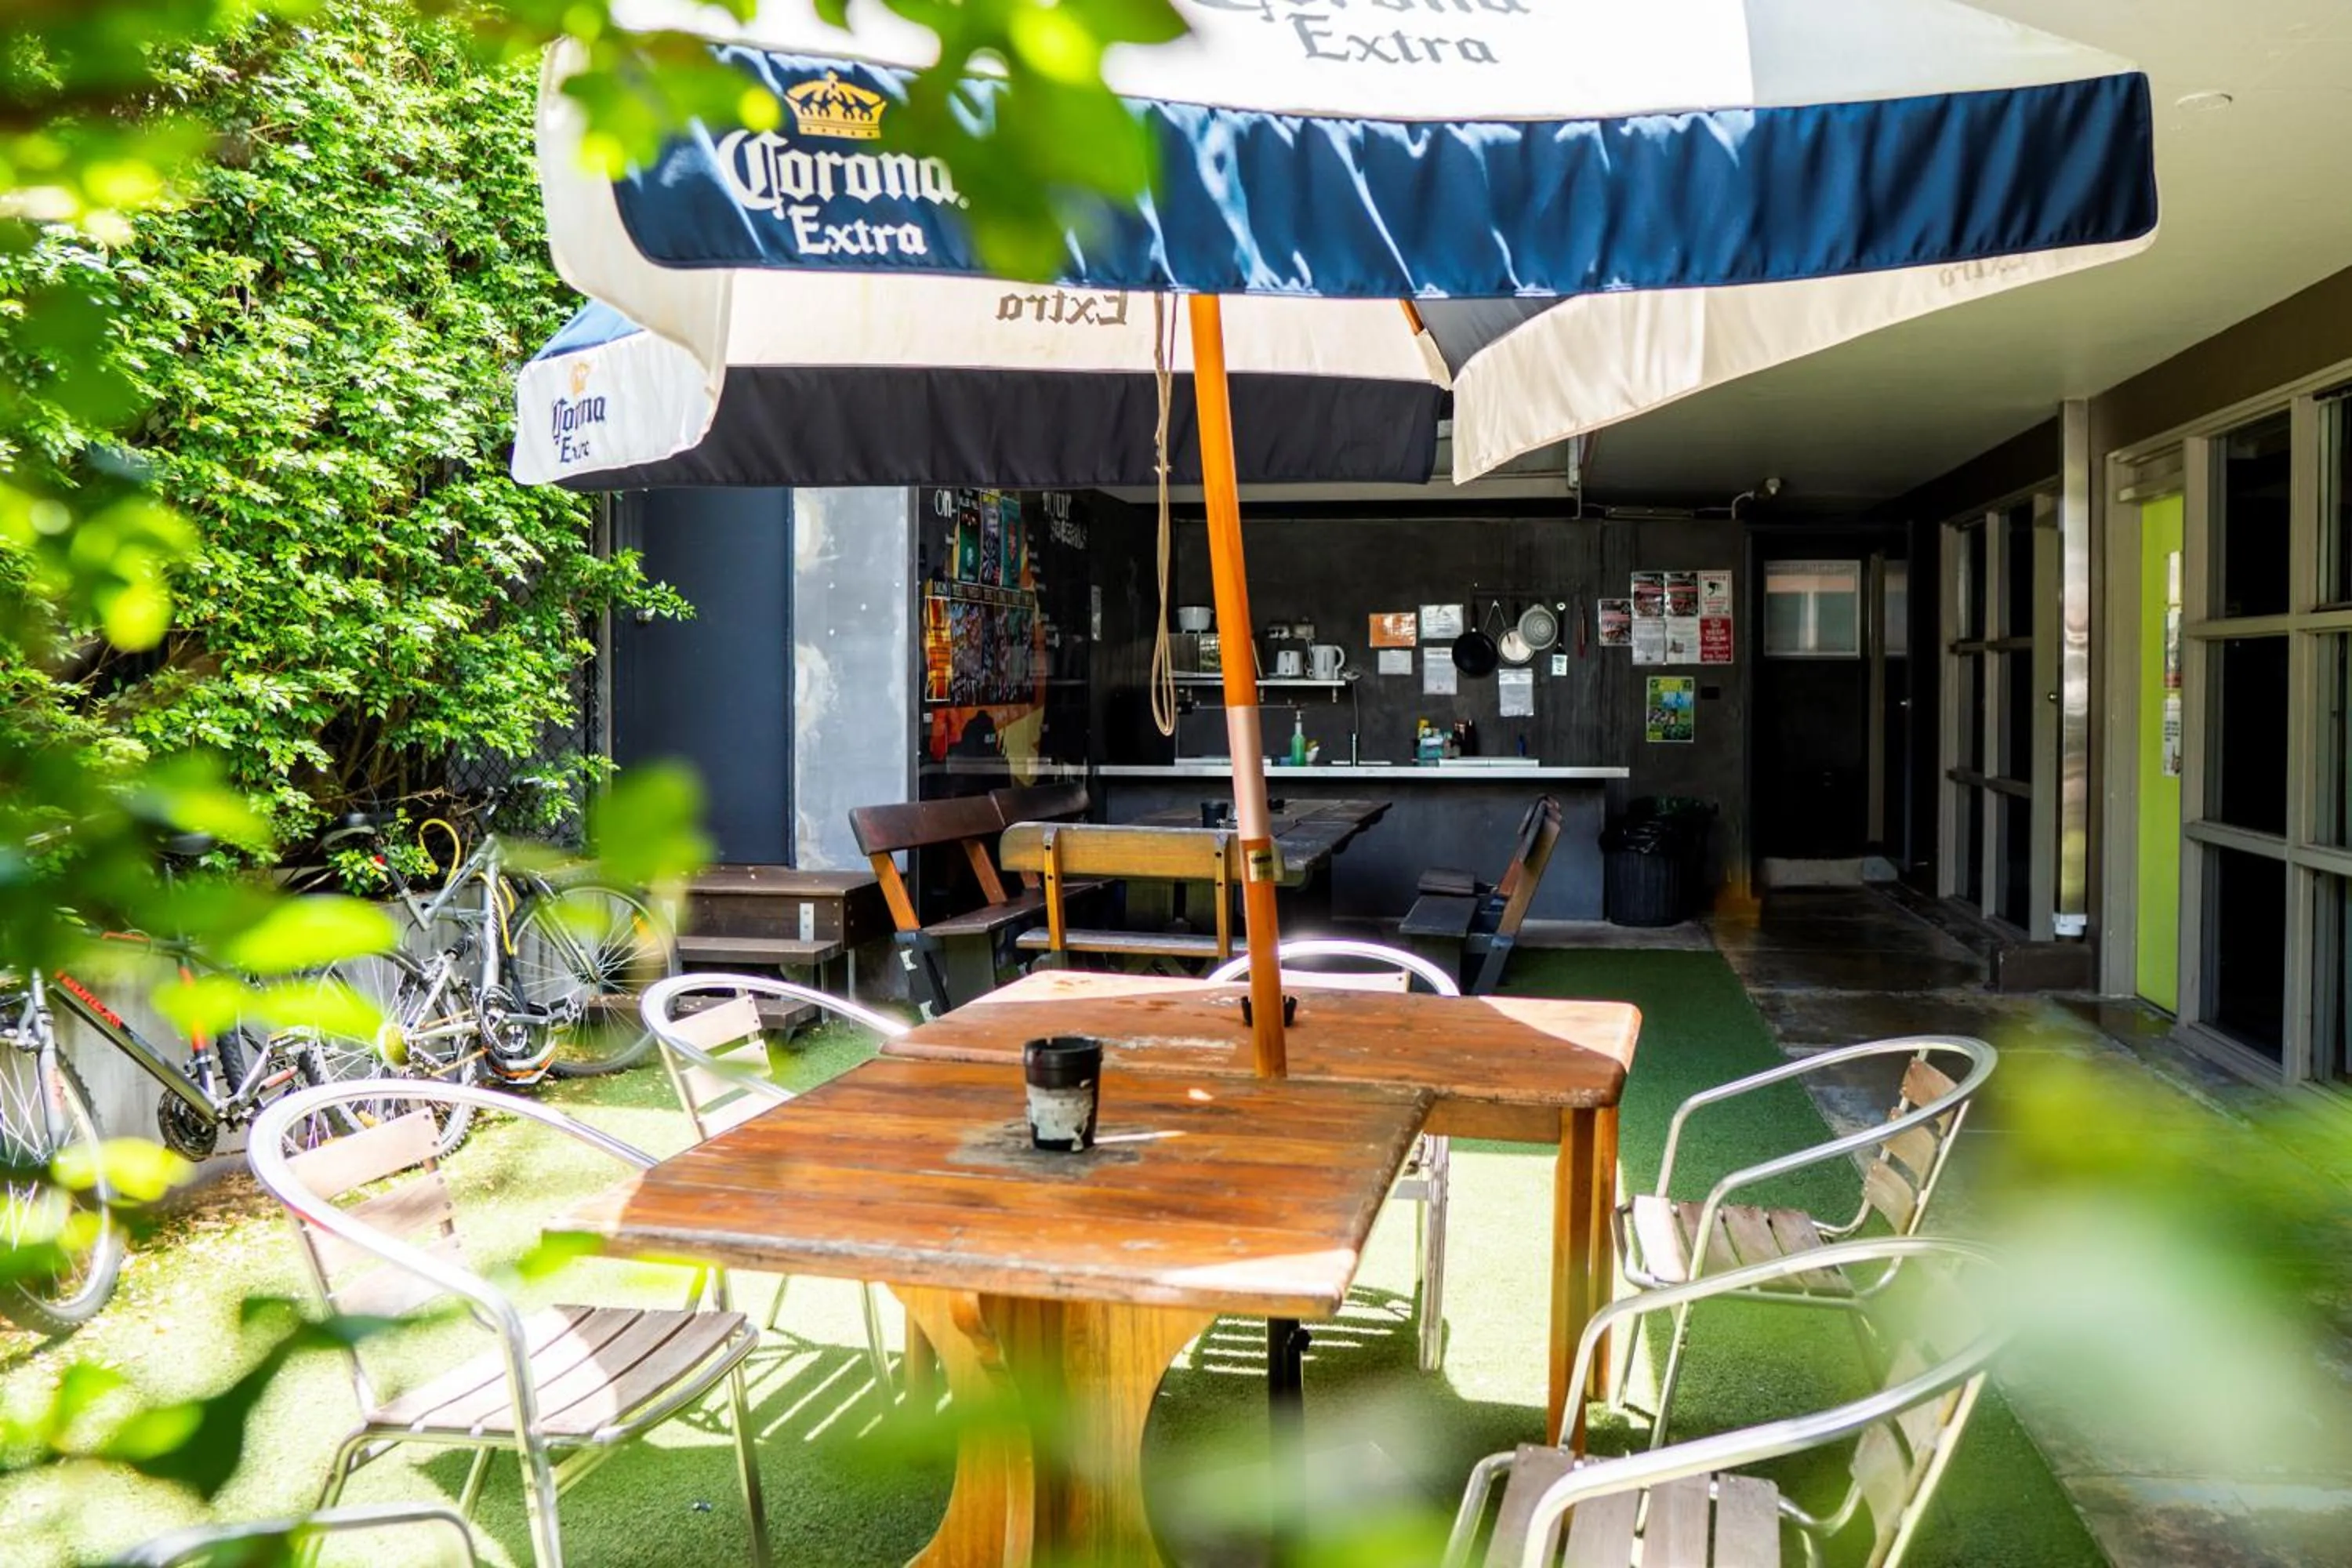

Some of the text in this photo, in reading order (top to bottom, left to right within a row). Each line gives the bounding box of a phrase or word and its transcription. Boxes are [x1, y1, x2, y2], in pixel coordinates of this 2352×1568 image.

[1285, 12, 1500, 64] Extra
[717, 128, 960, 220] Corona
[787, 205, 928, 256] Extra
[551, 395, 606, 446] Cona
